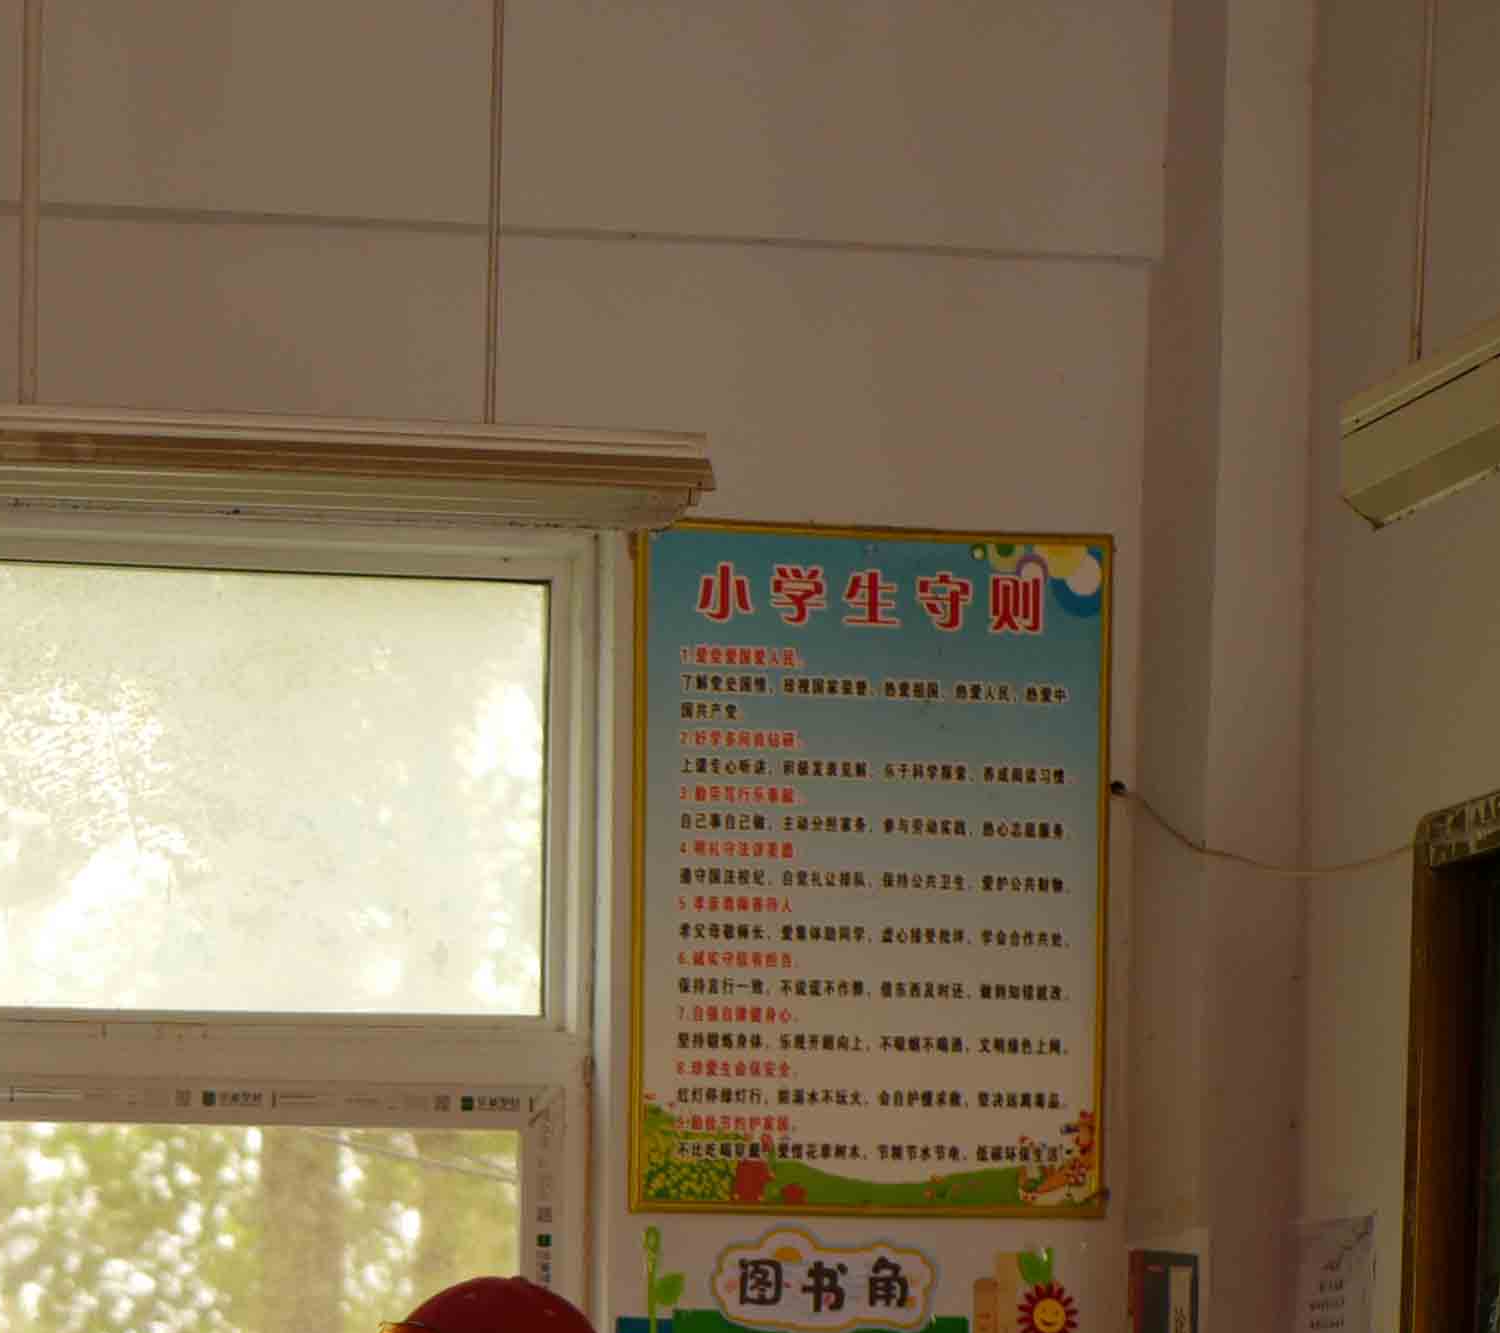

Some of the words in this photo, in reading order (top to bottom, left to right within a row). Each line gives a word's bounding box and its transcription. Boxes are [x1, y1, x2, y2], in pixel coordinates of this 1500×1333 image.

[697, 562, 1048, 634] 小学生守则
[738, 1257, 912, 1312] 图书角
